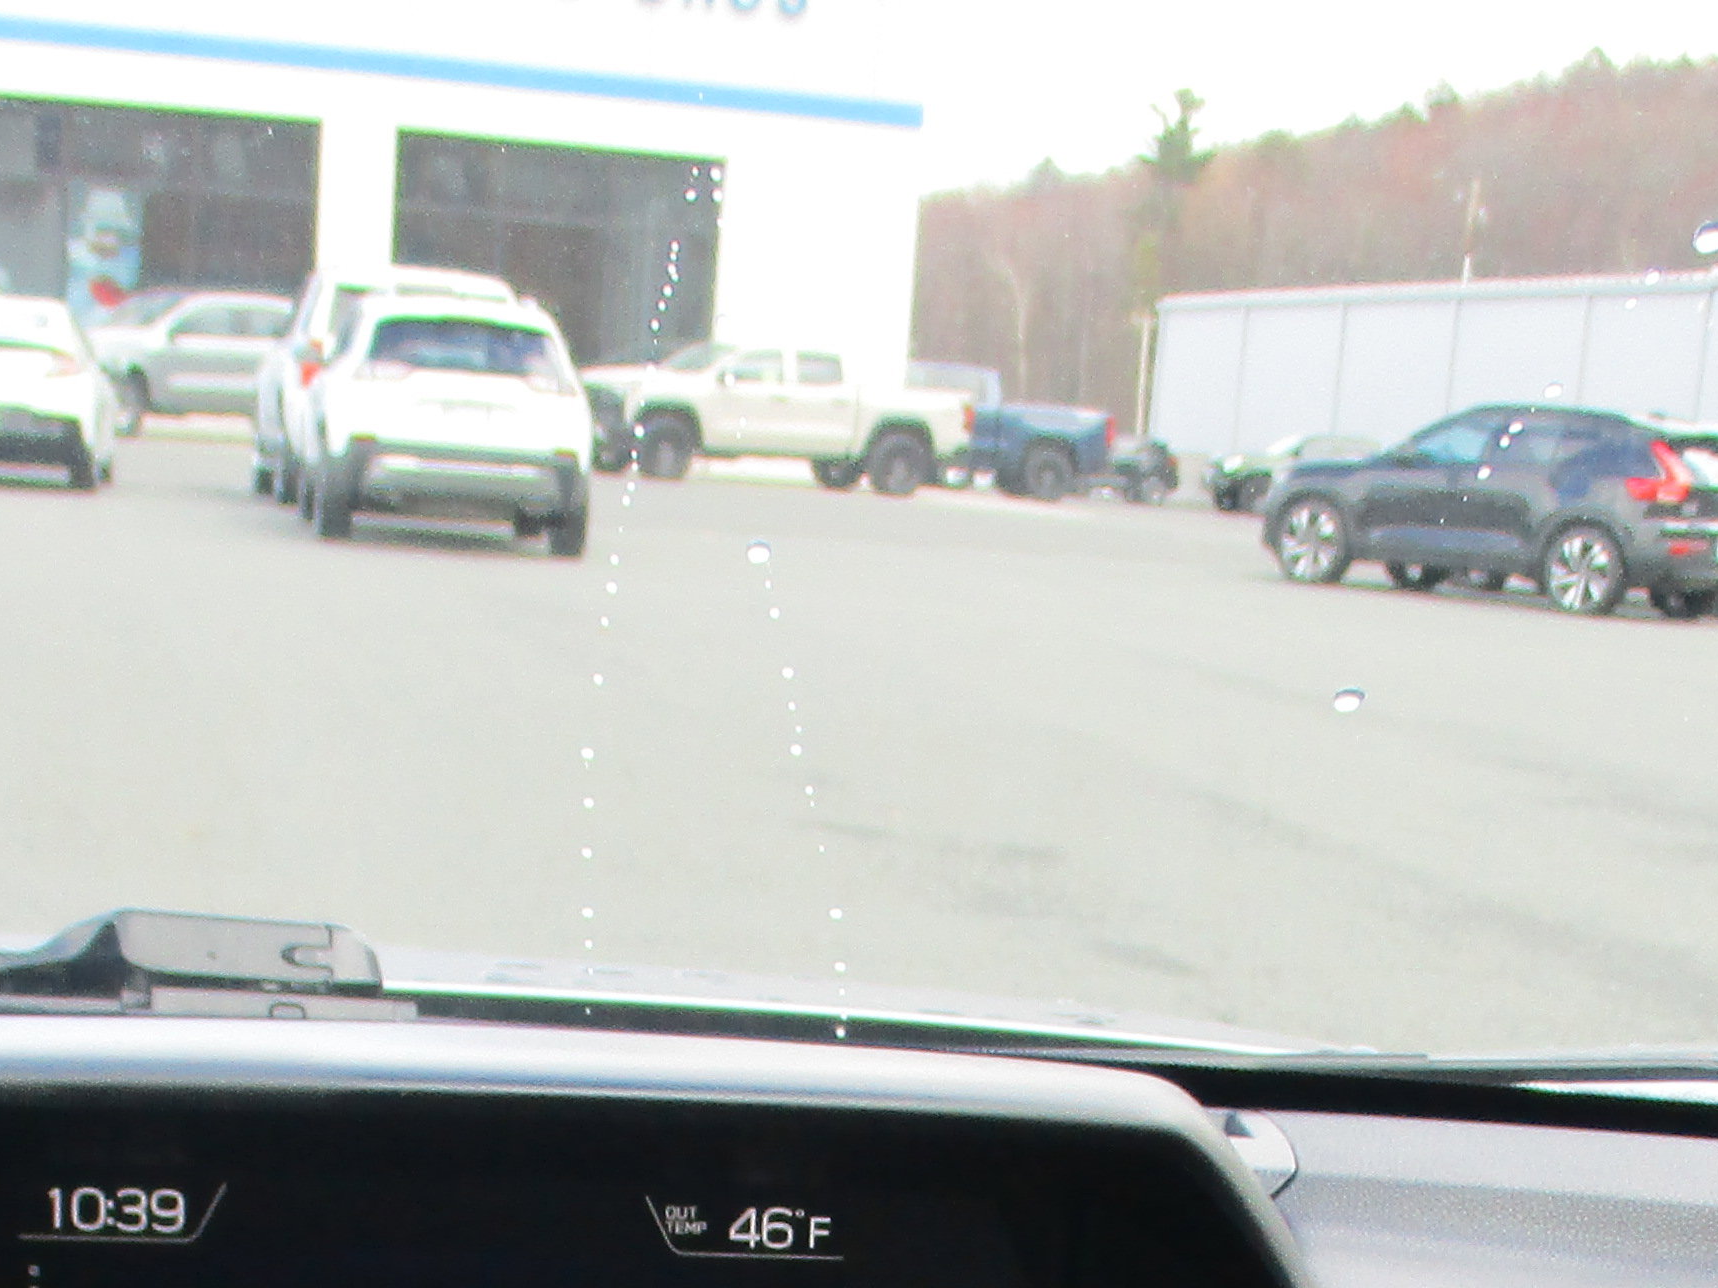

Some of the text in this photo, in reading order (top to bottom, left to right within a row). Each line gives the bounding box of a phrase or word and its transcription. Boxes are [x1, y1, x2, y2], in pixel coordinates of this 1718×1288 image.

[47, 1186, 186, 1234] 10:39
[664, 1205, 697, 1220] OUT
[664, 1220, 708, 1236] TEMP
